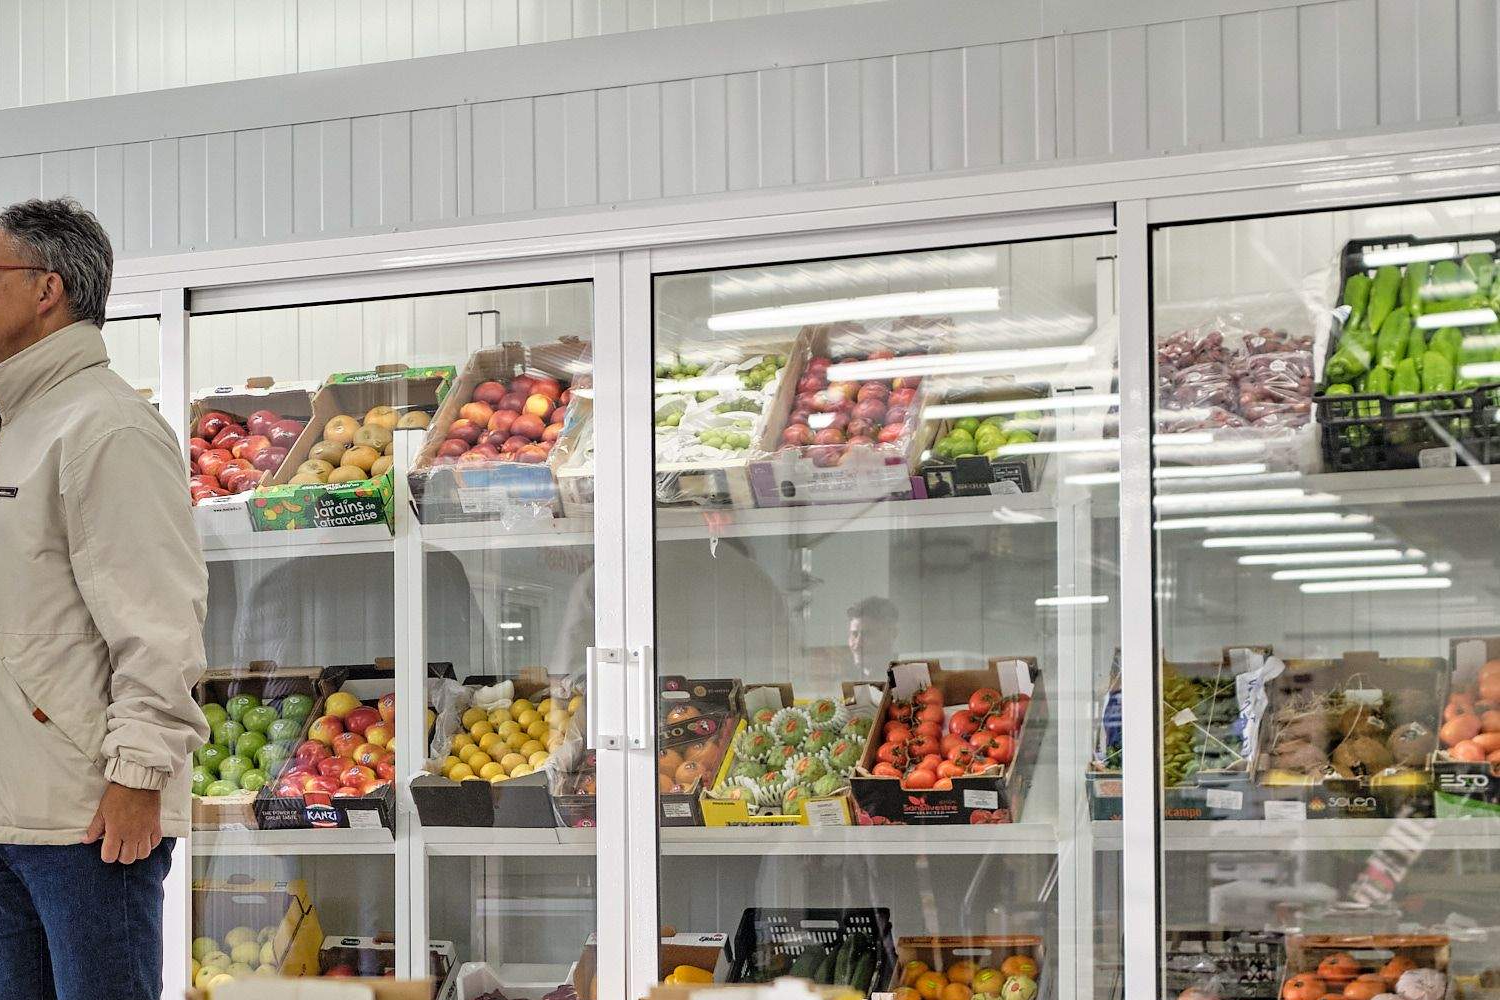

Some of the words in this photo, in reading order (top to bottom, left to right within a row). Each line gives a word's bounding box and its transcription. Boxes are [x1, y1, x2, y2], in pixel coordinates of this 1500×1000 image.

[313, 499, 364, 520] Jardins
[365, 503, 376, 511] de
[320, 499, 335, 508] Les
[313, 511, 378, 528] Lafrançaise
